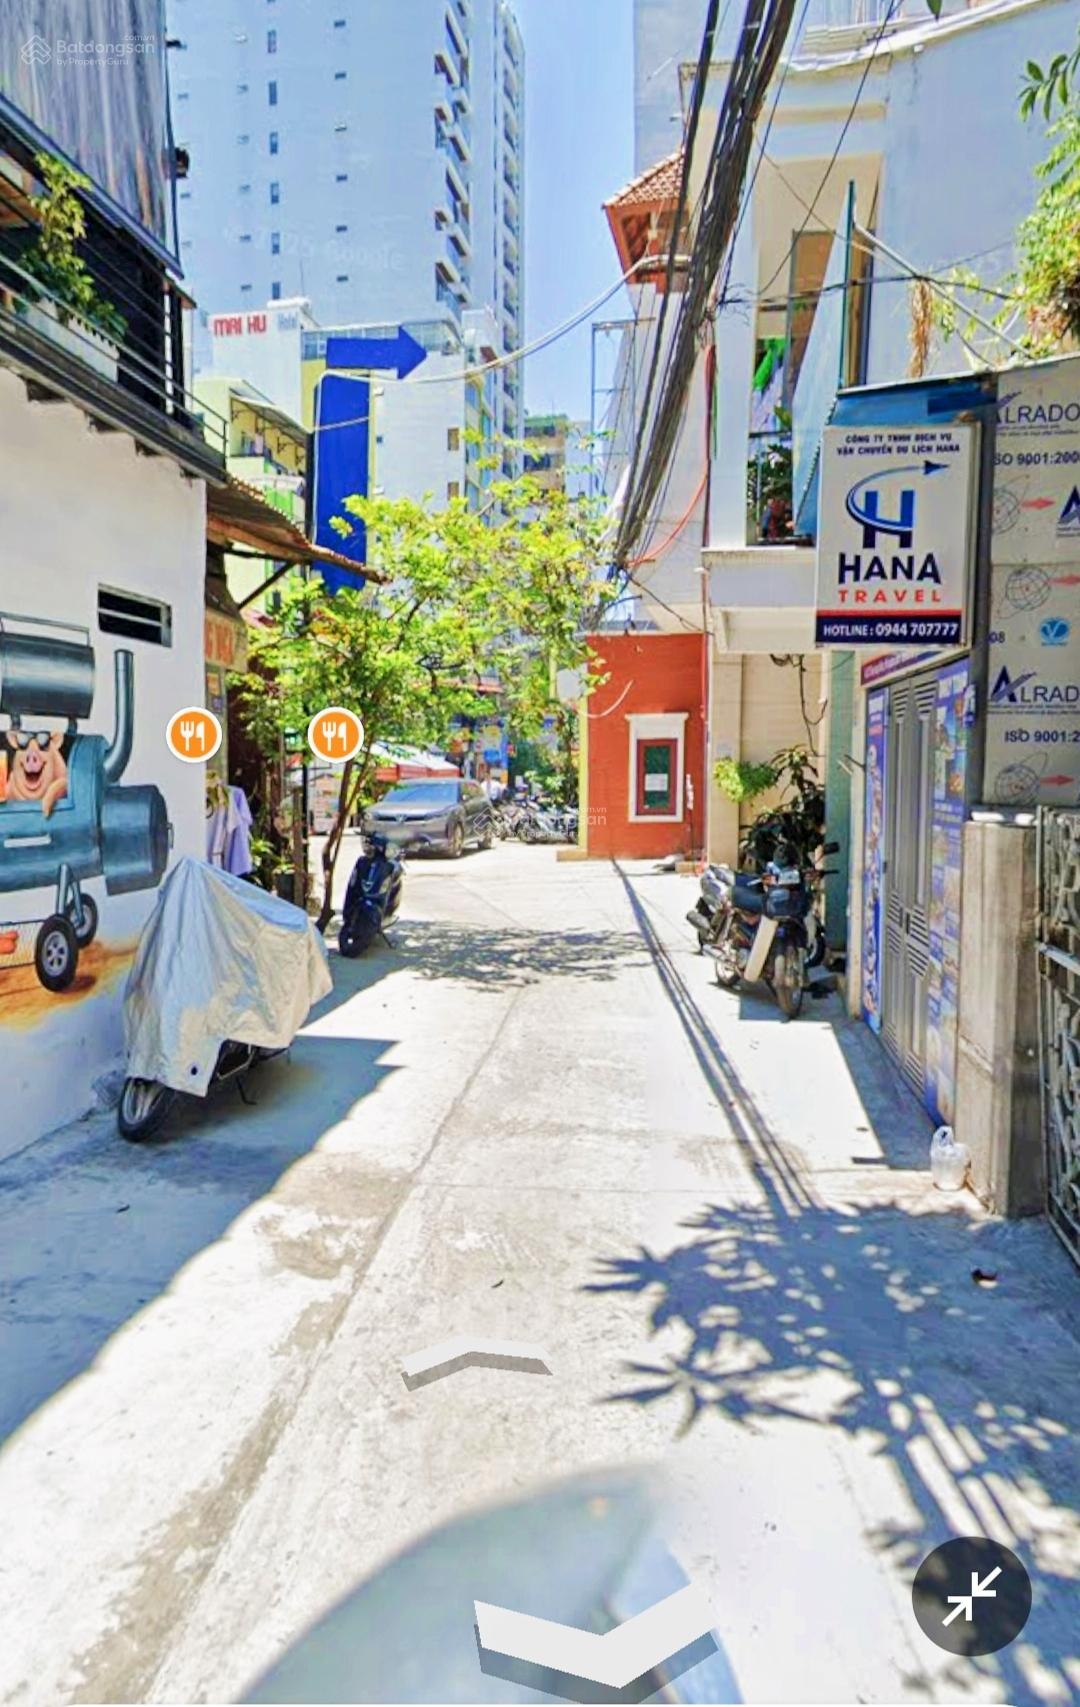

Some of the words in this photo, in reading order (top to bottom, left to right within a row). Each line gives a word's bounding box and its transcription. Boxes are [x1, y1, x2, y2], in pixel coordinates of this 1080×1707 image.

[874, 434, 883, 443] TY
[896, 445, 908, 454] DU
[936, 444, 960, 453] HANA
[838, 552, 941, 584] HANA
[838, 589, 941, 603] TRAVEL
[875, 622, 908, 637] 0944
[909, 622, 958, 637] 707777
[1004, 730, 1030, 742] ISO
